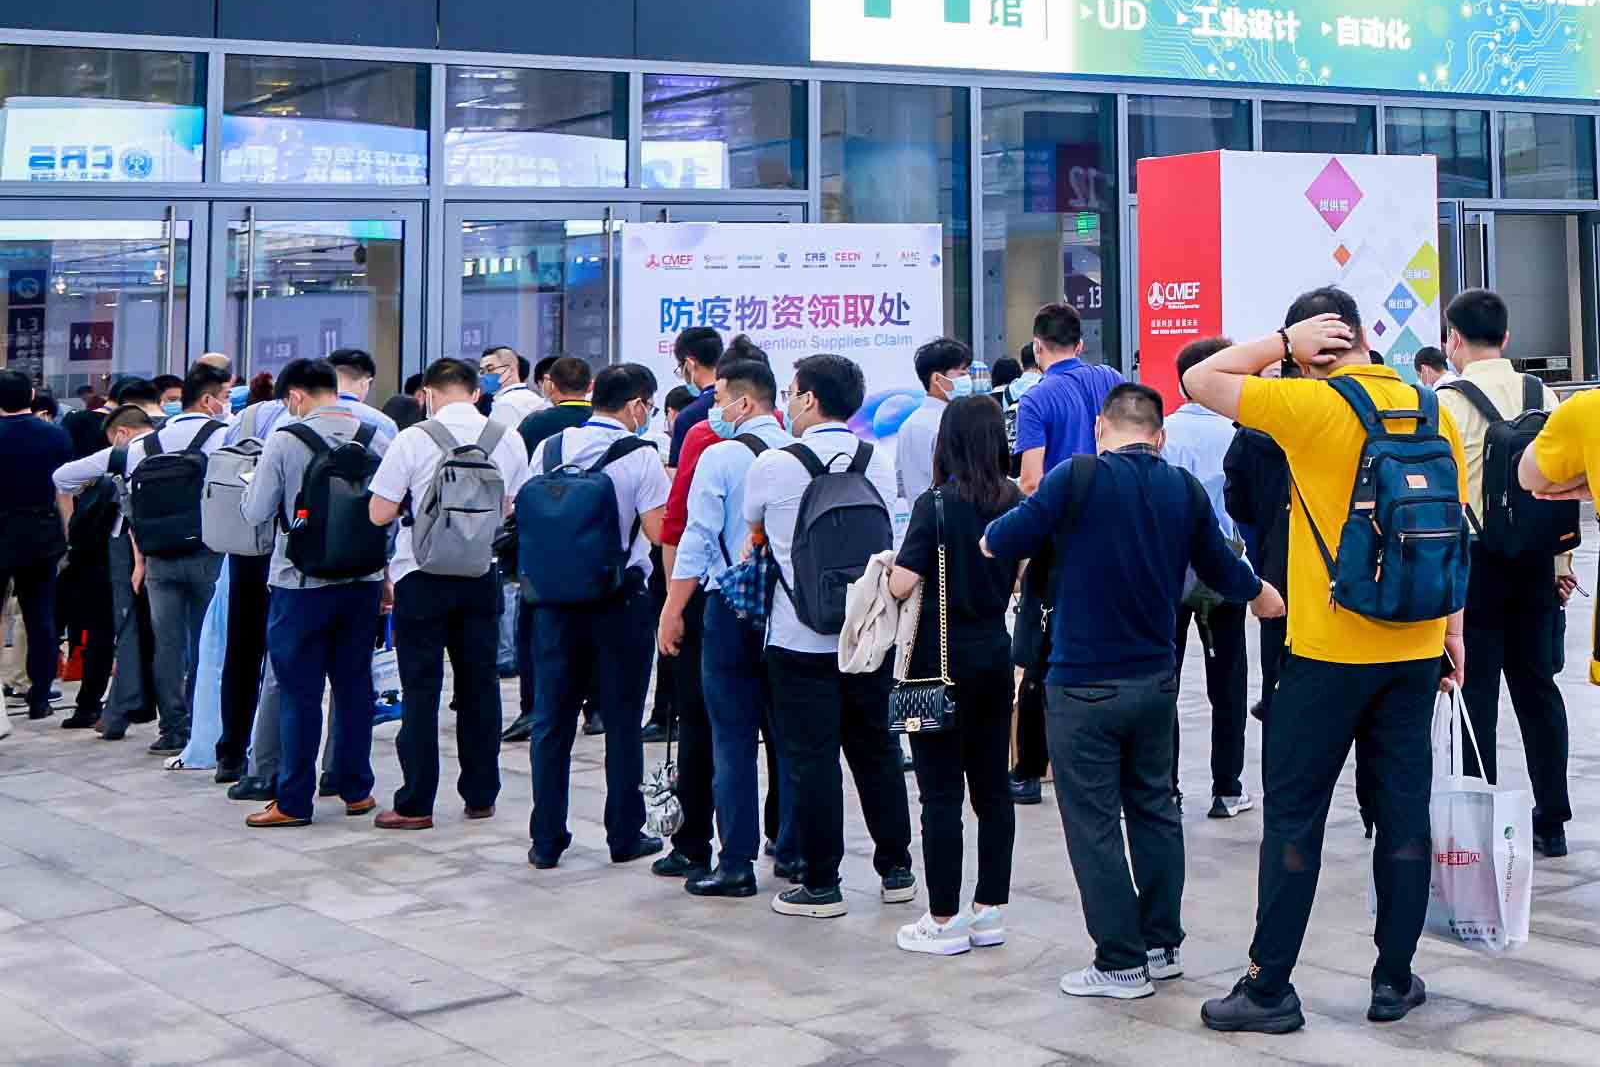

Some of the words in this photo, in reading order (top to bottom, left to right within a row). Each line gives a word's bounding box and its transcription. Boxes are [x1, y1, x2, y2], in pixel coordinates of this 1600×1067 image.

[1191, 6, 1300, 42] 工业设计
[1336, 16, 1412, 50] 自动化
[661, 254, 694, 265] CMEF
[1165, 281, 1201, 301] CMEF
[658, 291, 912, 333] 防疫物资领取处
[810, 333, 872, 352] Supplies
[874, 332, 913, 347] Claim
